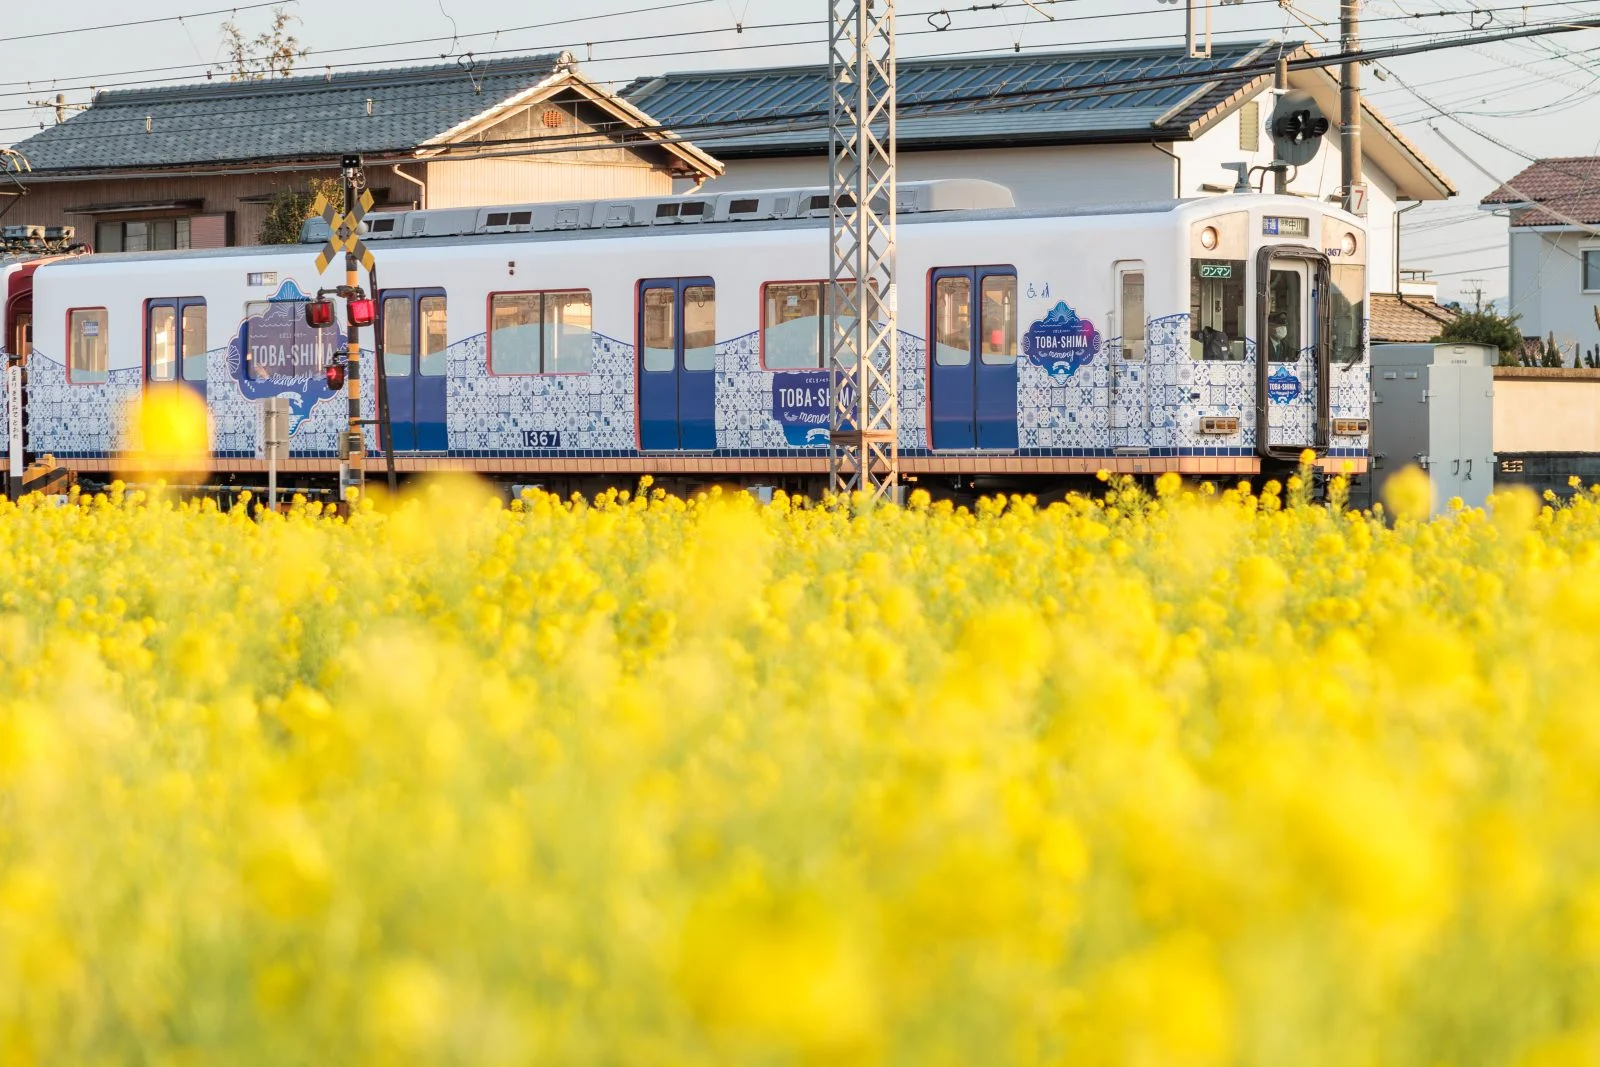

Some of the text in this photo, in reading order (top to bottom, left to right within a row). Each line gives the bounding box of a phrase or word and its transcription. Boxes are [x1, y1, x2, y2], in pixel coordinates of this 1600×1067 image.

[1354, 189, 1364, 210] 7
[1325, 247, 1342, 257] 1367
[1203, 267, 1230, 276] ワンマン
[1034, 335, 1088, 349] TOBA-SHIMA
[251, 343, 334, 367] TOBA-SHIMA
[779, 388, 858, 408] TOBA-SHMA
[524, 431, 557, 446] 1367
